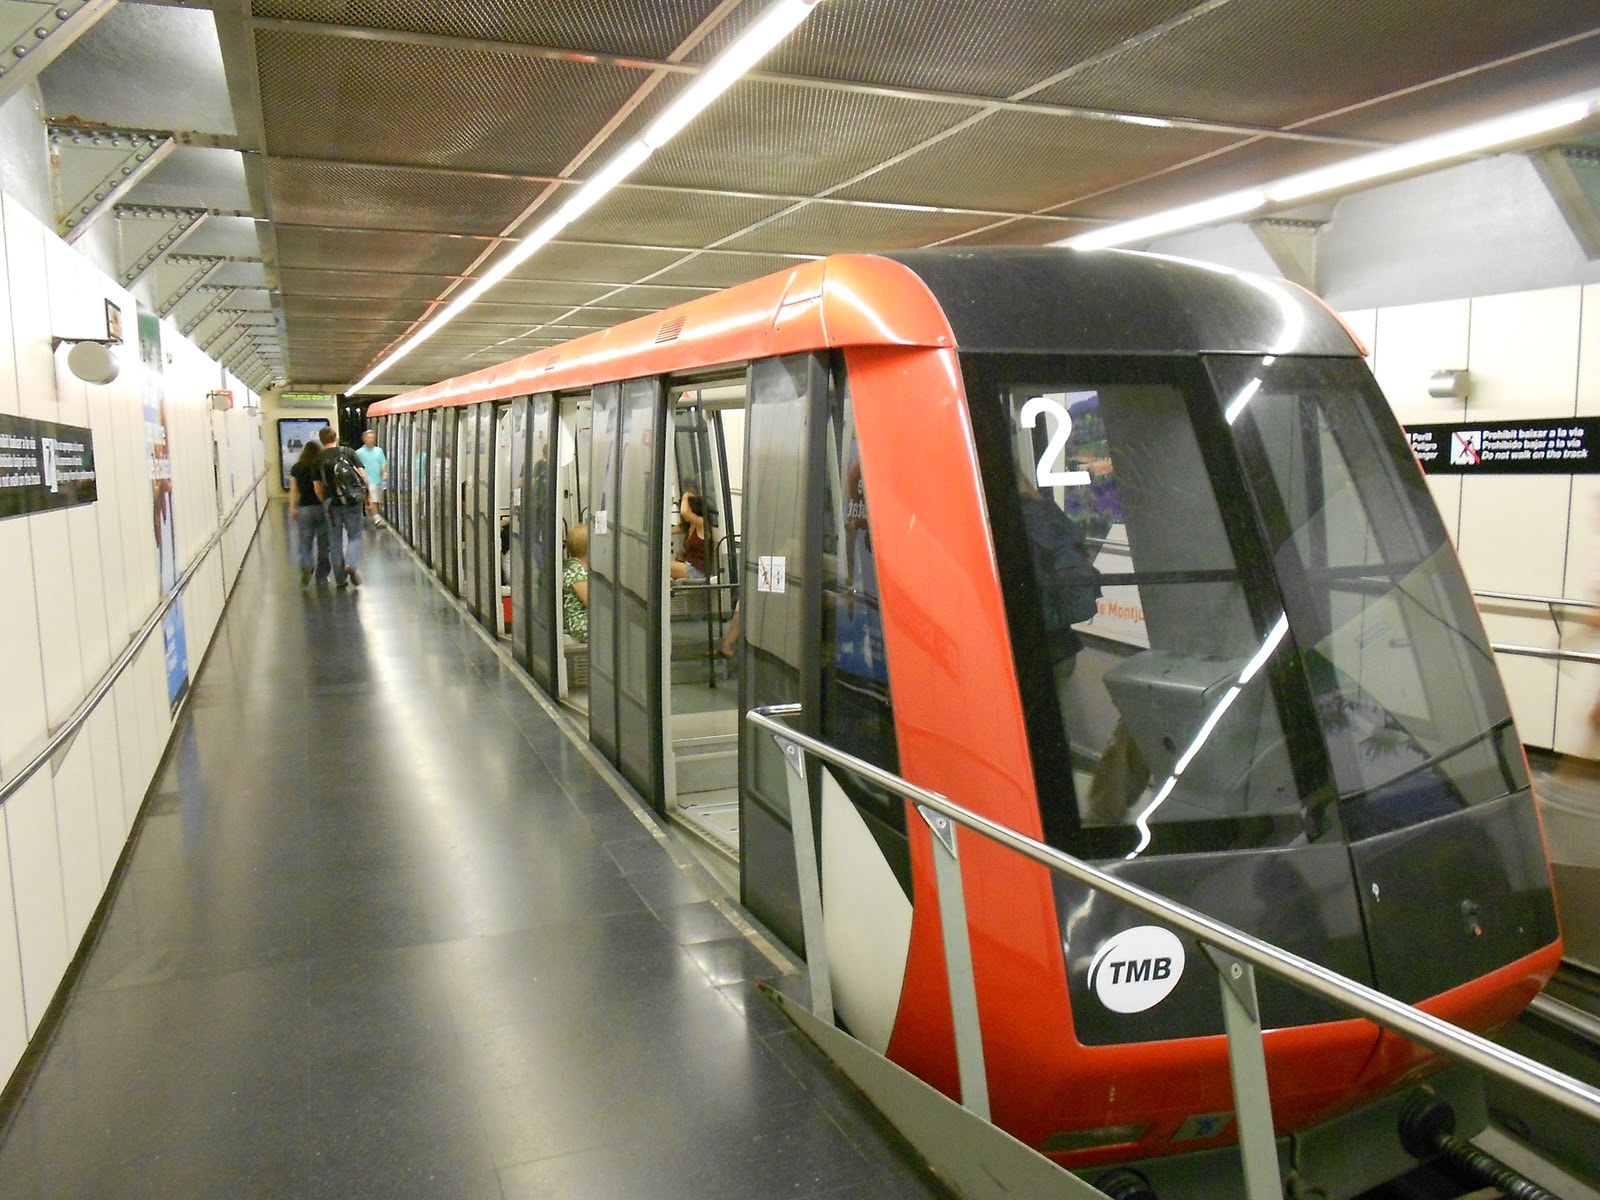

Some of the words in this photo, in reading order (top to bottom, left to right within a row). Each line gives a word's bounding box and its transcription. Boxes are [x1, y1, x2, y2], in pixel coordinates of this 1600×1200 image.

[1483, 430, 1517, 440] Prohibit
[1518, 428, 1548, 439] baixar
[1549, 430, 1556, 438] a
[1557, 427, 1567, 438] la
[1020, 396, 1092, 488] 2
[1412, 442, 1437, 451] Peligro
[1482, 440, 1522, 450] Prohibido
[1524, 440, 1547, 450] bajar
[1548, 441, 1555, 449] a
[1556, 438, 1566, 449] la
[1481, 450, 1494, 460] Do
[1494, 450, 1510, 460] not
[1510, 449, 1531, 460] walk
[1532, 450, 1545, 460] on
[1546, 448, 1562, 459] the
[1562, 448, 1588, 460] track
[1110, 957, 1172, 985] TMB
